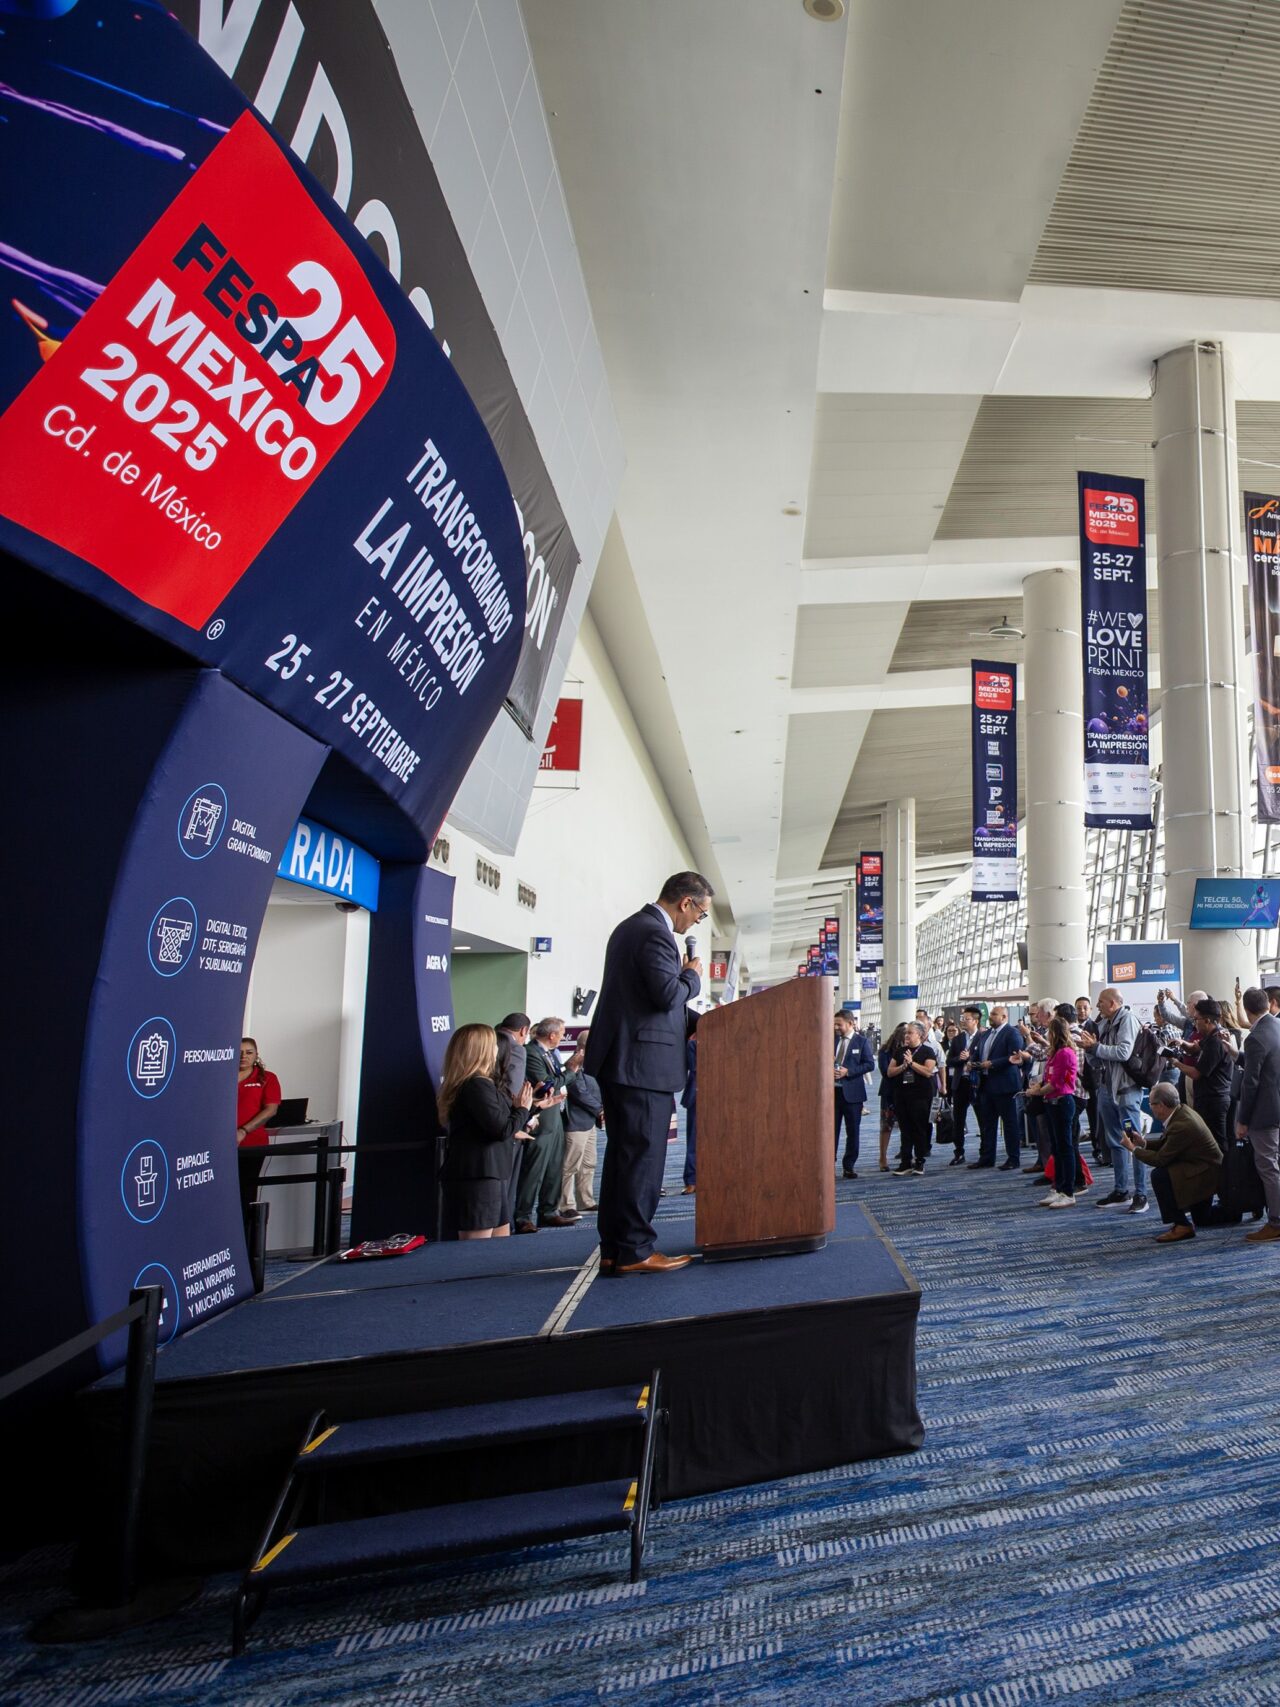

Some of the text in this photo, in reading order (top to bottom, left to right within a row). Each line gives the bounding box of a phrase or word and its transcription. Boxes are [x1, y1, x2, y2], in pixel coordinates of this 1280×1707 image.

[172, 222, 322, 407] FESPA
[246, 260, 384, 425] 25
[126, 278, 317, 480] MEXICO
[80, 343, 228, 471] 2025
[43, 405, 222, 550] Cd. de México
[1104, 495, 1135, 513] 25
[1089, 510, 1136, 522] MEXICO
[1089, 519, 1117, 528] 2025
[406, 438, 514, 644] TRANSFORMANDO
[1260, 529, 1276, 537] hotel
[1092, 552, 1133, 567] 25-27
[1093, 567, 1133, 583] SEPT.
[353, 497, 485, 695] LA IMPRESIÓN
[1088, 626, 1142, 647] LOVE
[355, 596, 443, 711] EN MÉXICO
[1088, 645, 1143, 668] PRINT
[1088, 667, 1144, 678] FESPA MEXICO
[978, 686, 1011, 694] MEXICO
[265, 634, 311, 680] 25
[314, 671, 351, 710] 27
[342, 693, 420, 784] SEPTIEMBRE
[980, 714, 1008, 724] 25-27
[980, 725, 1008, 735] SEPT.
[1087, 740, 1148, 750] LA IMPRESIÓN
[232, 819, 256, 839] DIGITAL
[227, 837, 271, 864] GRAN FORMATO
[206, 919, 231, 935] DIGITAL
[199, 956, 205, 969] Y
[426, 955, 441, 970] AGFA
[1115, 965, 1133, 975] EXPO
[431, 1015, 450, 1033] EPSON
[183, 1045, 234, 1064] PERSONALIZACIÓN
[176, 1151, 210, 1171] EMPAQUE
[176, 1168, 214, 1190] Y ETIQUETA
[182, 1248, 231, 1280] HERRAMIENTAS
[185, 1264, 236, 1299] PARA WRAPPING
[188, 1283, 235, 1318] Y MUCHO MÁS
